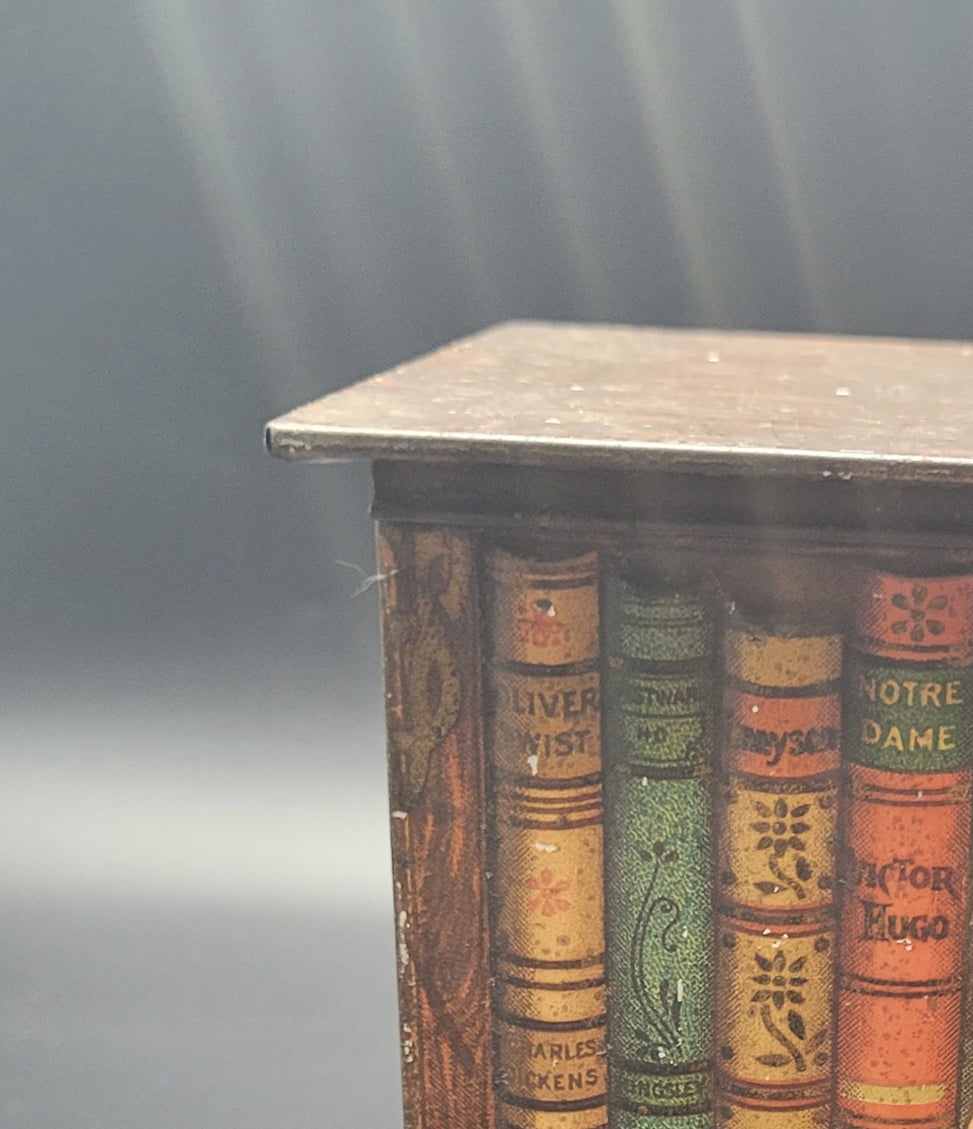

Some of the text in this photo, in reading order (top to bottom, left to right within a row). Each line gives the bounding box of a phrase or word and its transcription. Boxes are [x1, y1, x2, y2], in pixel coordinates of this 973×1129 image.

[505, 685, 601, 718] LIVER
[858, 677, 964, 708] NOTRE
[507, 729, 593, 760] WIST
[862, 718, 957, 752] DAME
[859, 898, 950, 943] HUGO
